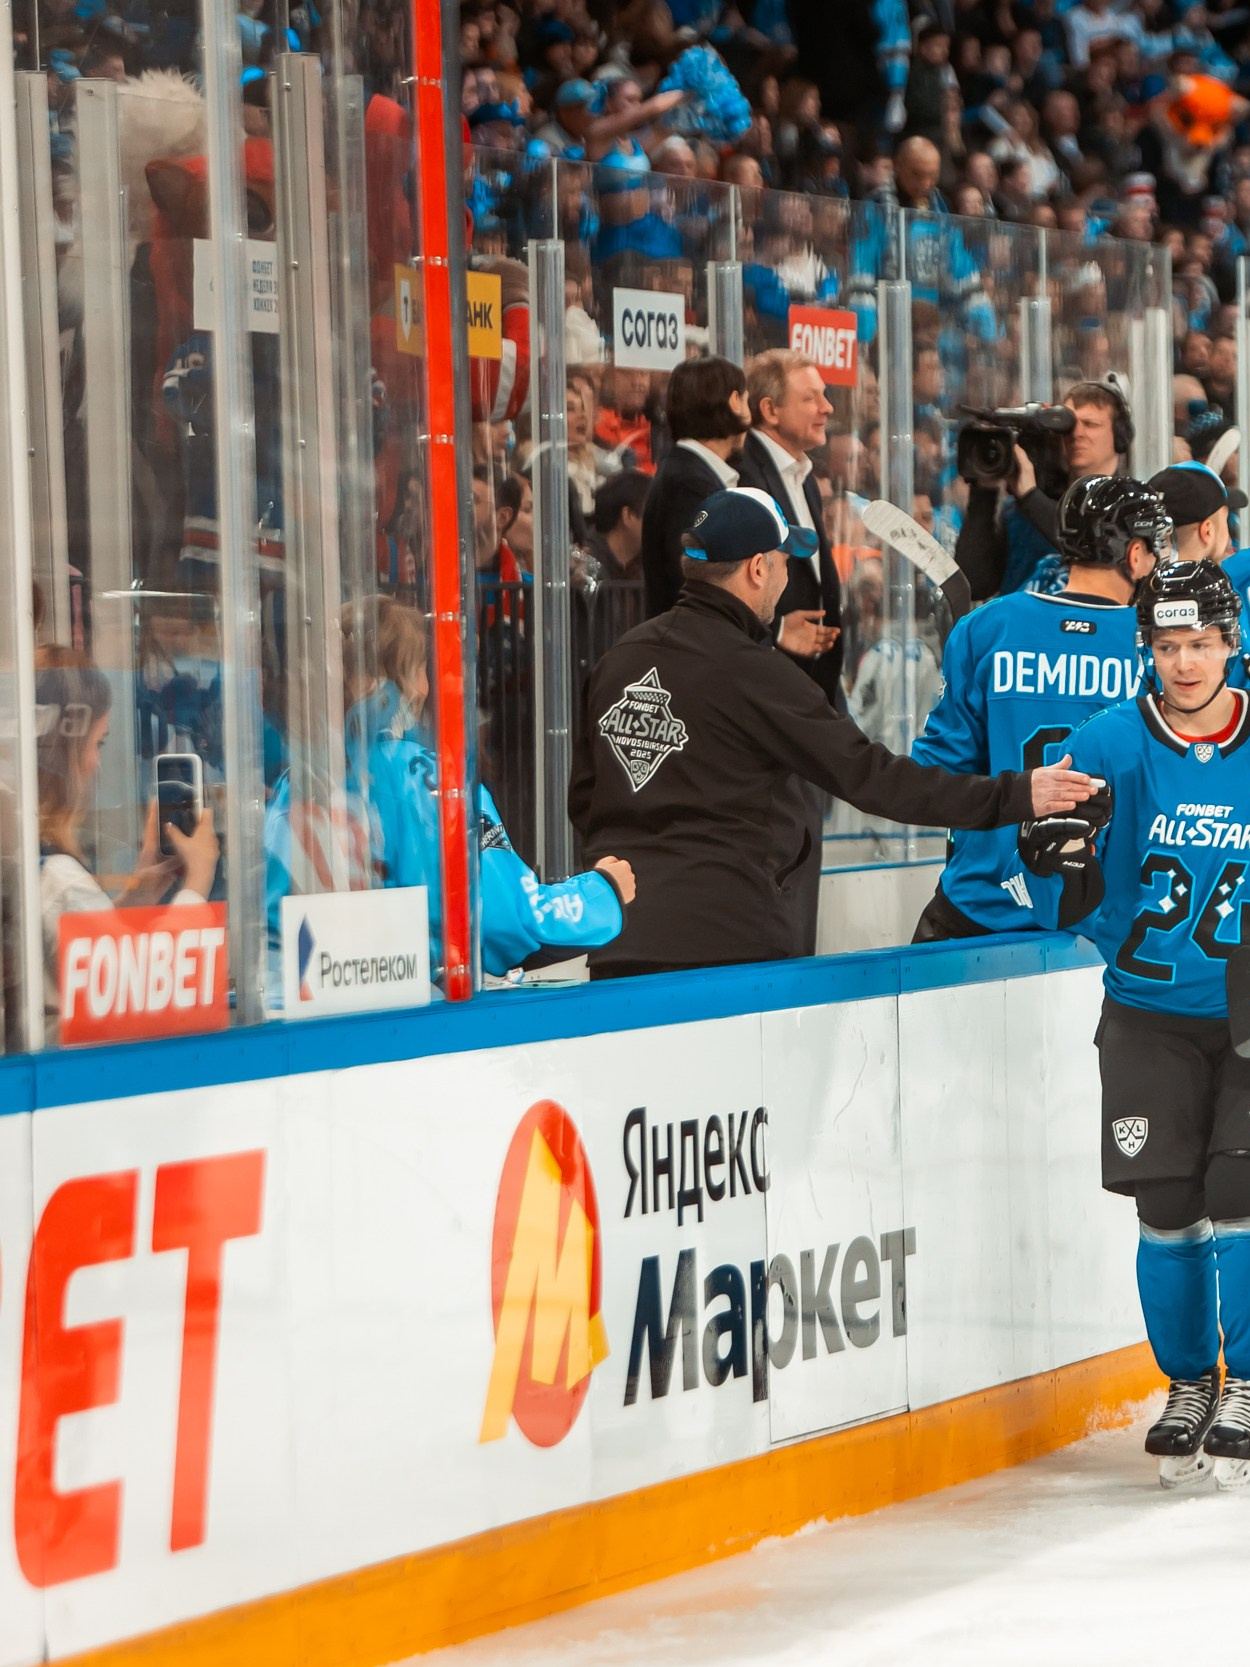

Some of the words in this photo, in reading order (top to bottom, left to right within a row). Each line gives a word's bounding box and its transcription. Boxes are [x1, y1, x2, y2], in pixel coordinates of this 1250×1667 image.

[790, 322, 857, 369] FONBET
[993, 650, 1154, 700] DEMIDOV
[628, 700, 660, 714] FONBET
[615, 735, 664, 752] NOVOSIBIRSK
[630, 748, 652, 760] 2025
[1176, 803, 1234, 819] FONBET
[63, 927, 226, 1020] FONBET
[320, 950, 418, 989] Ростелеком
[622, 1107, 771, 1227] Яндекс
[623, 1226, 917, 1407] Маркет
